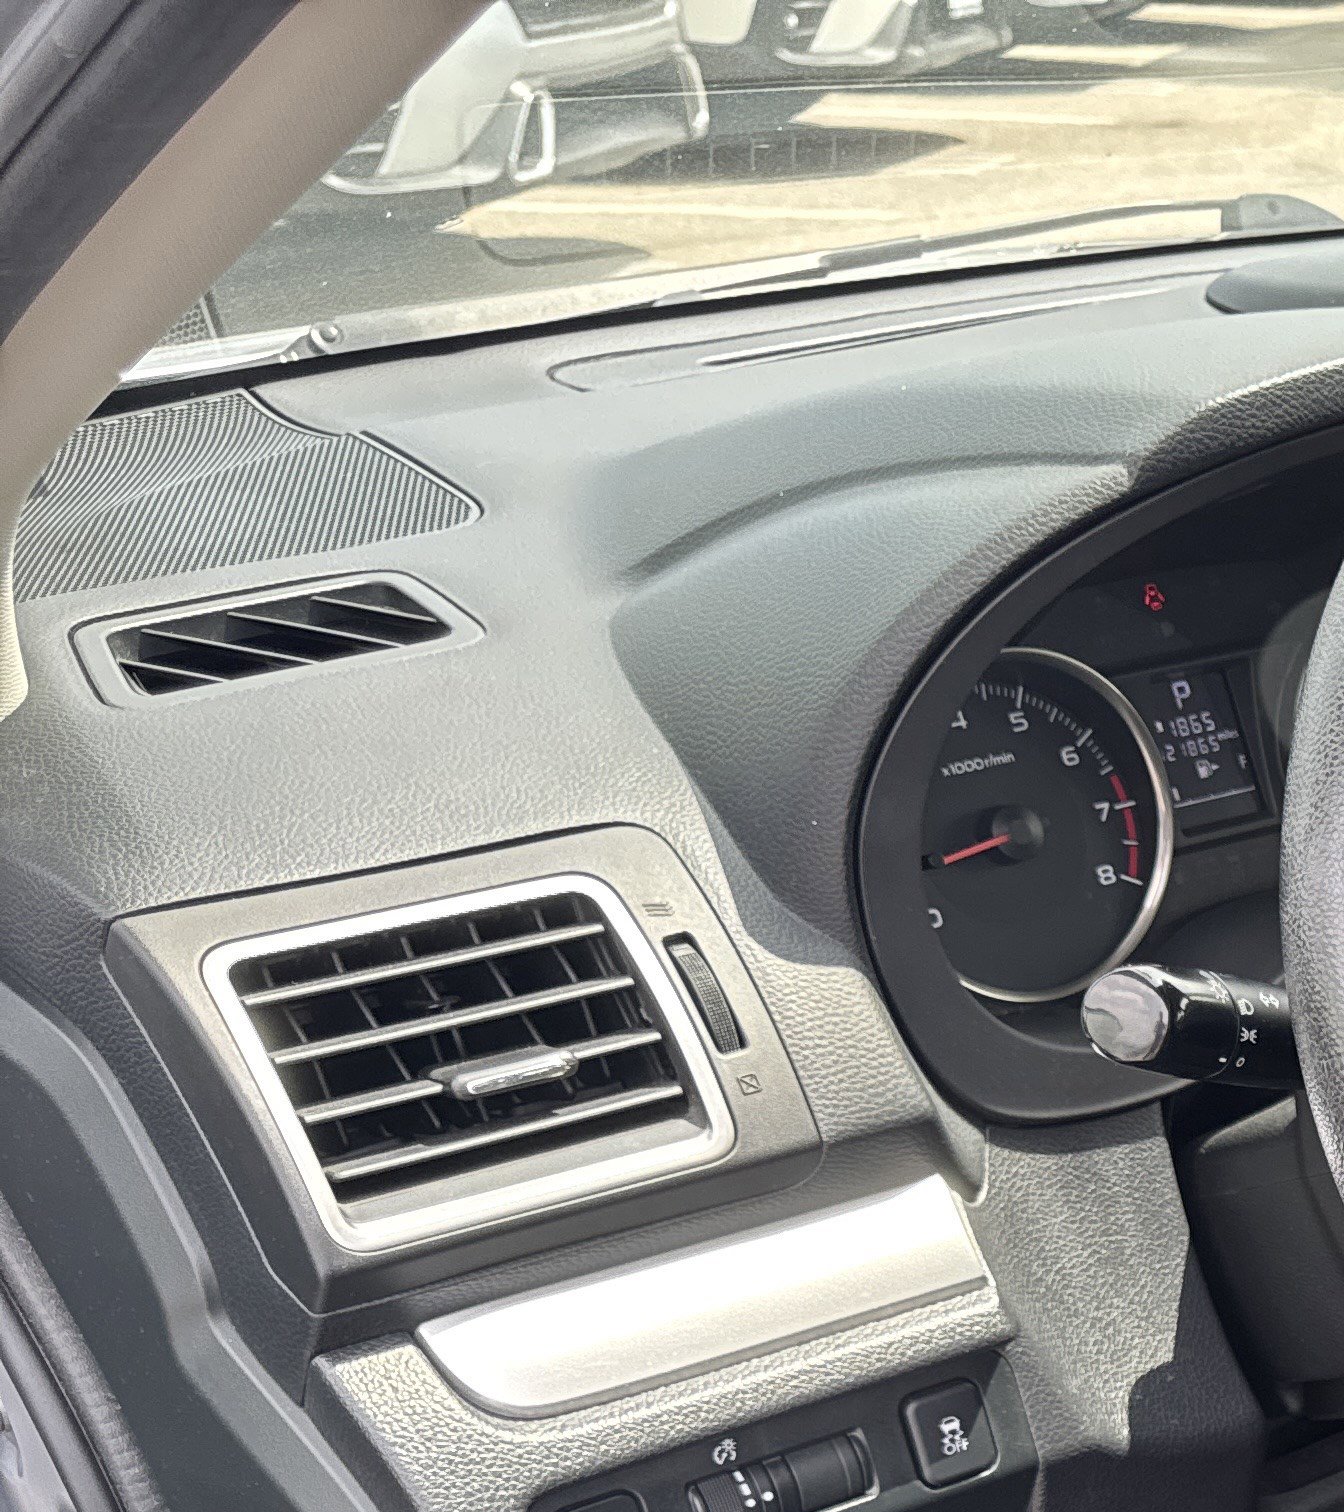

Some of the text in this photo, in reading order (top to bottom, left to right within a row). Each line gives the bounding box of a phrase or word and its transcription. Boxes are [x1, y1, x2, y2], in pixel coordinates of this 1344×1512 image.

[1171, 680, 1192, 711] P
[1007, 710, 1029, 733] 5
[1059, 745, 1080, 767] 6
[1093, 801, 1110, 822] 7
[1095, 864, 1117, 886] 8
